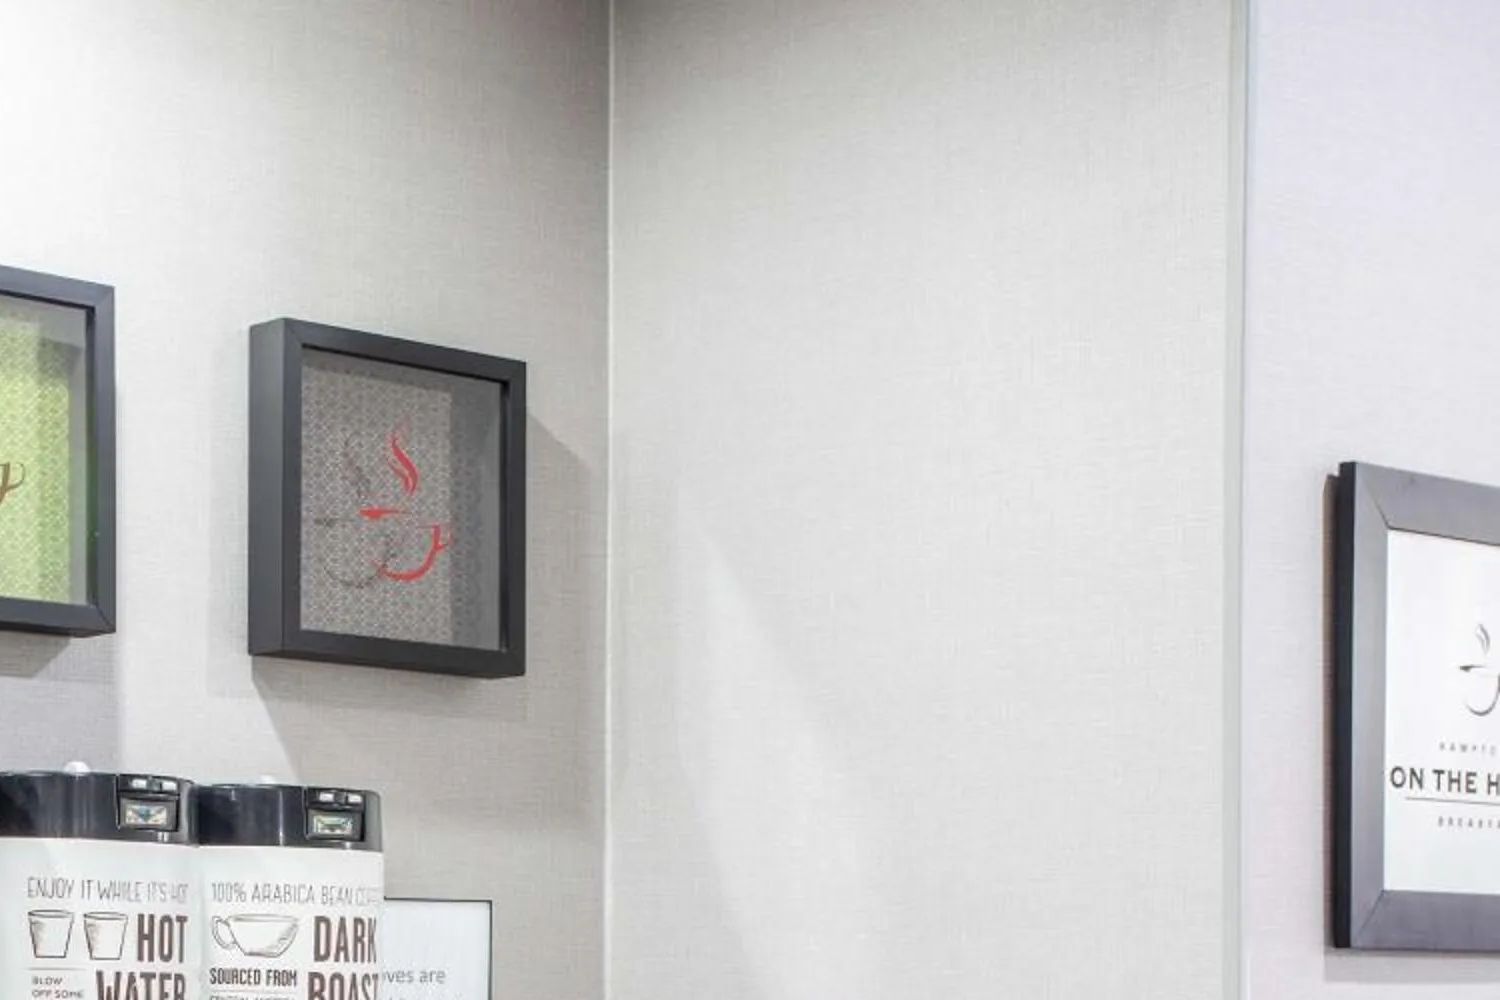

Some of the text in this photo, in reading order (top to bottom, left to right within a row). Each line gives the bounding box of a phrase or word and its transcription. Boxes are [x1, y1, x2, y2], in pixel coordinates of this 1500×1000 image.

[1390, 766, 1424, 790] ON
[1432, 768, 1477, 794] THE
[27, 876, 74, 899] ENJOY
[81, 879, 95, 900] IT
[97, 879, 143, 902] WHILE
[211, 882, 246, 903] 100%
[251, 882, 315, 904] ARABICA
[321, 884, 352, 906] BEAN
[137, 913, 188, 963] HOT
[313, 916, 377, 963] DARK
[32, 976, 63, 986] BLOW
[209, 968, 297, 986] SOURCED FROM
[383, 970, 446, 984] ves are
